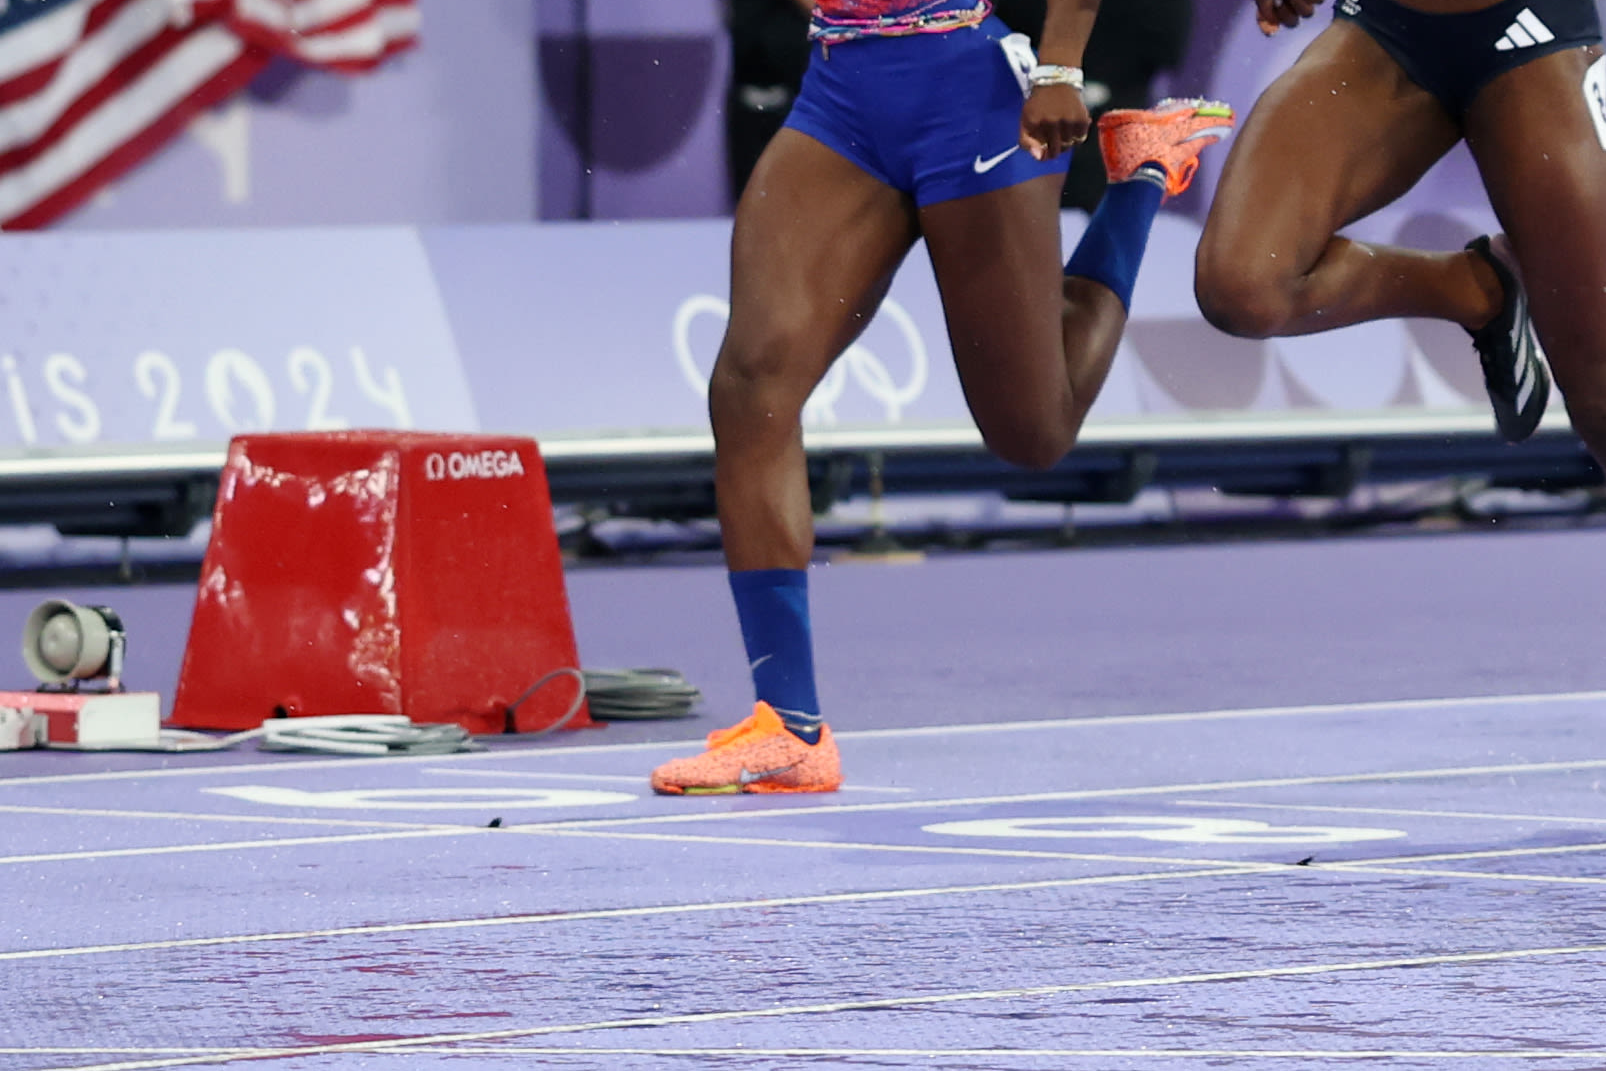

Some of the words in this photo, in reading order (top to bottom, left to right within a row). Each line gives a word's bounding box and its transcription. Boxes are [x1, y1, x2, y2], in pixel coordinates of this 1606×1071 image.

[134, 344, 415, 439] 2024
[447, 450, 526, 480] OMEGA
[921, 816, 1408, 843] 8
